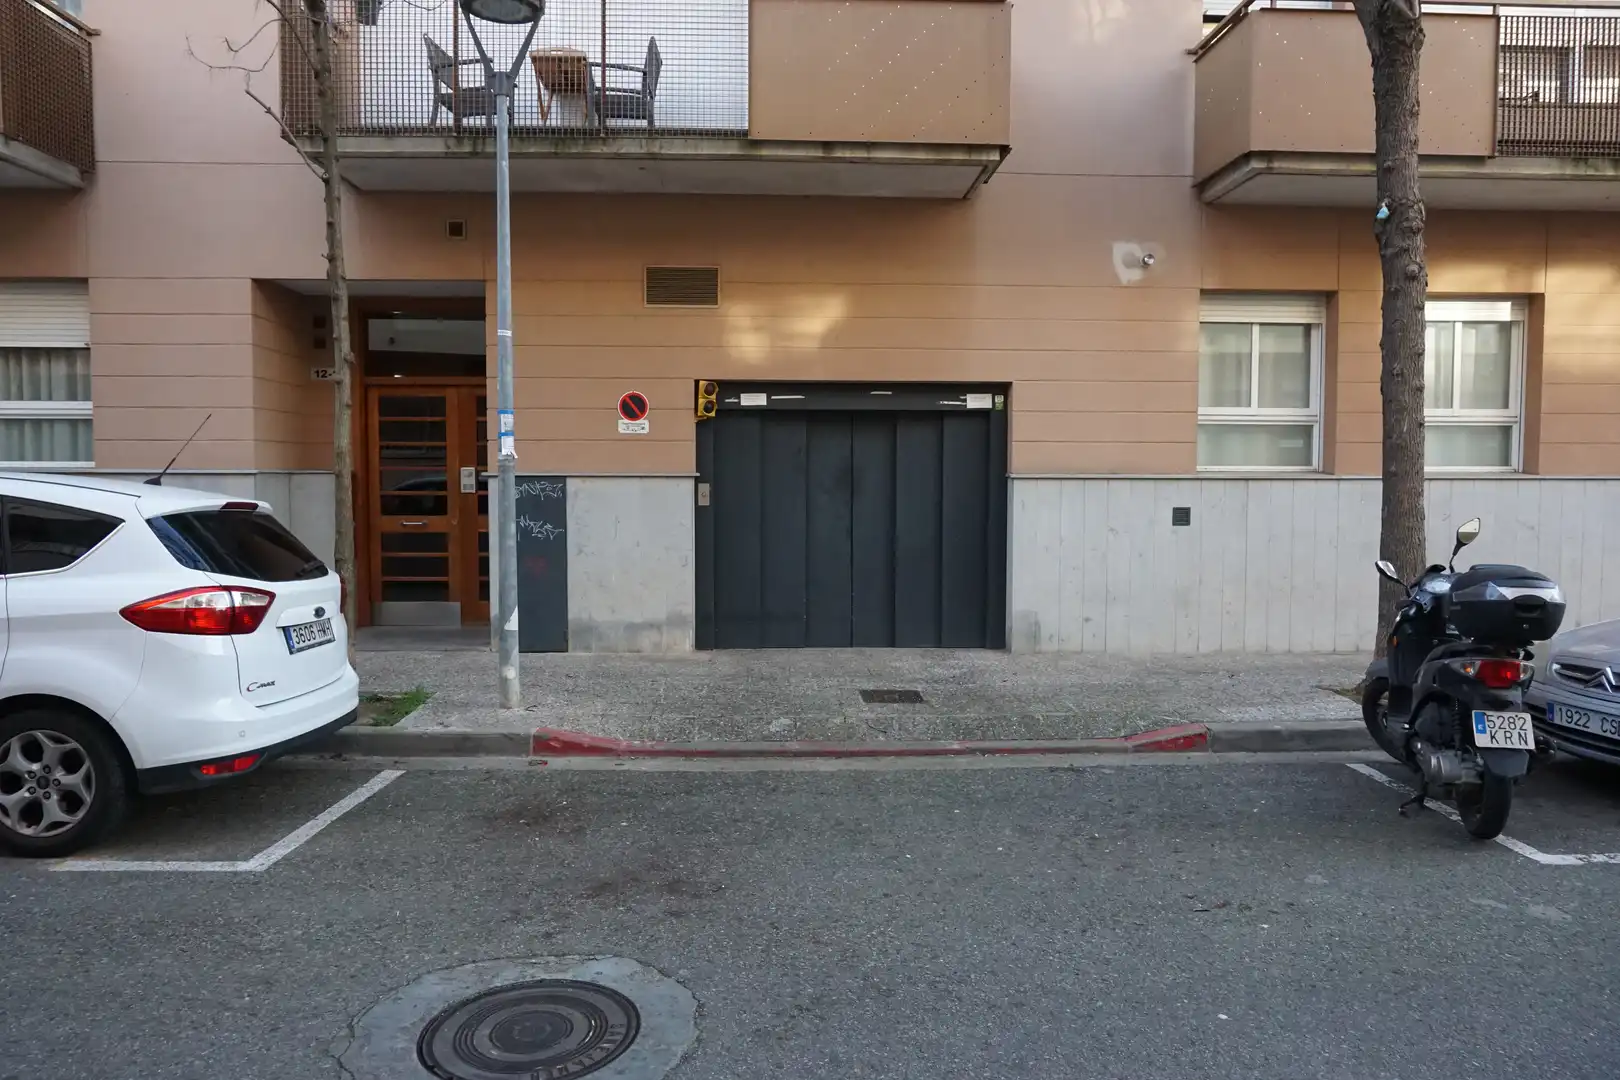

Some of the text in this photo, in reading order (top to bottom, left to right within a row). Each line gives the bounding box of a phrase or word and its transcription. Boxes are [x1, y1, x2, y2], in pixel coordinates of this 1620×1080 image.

[314, 369, 336, 379] 12-
[293, 624, 316, 645] 3606
[1486, 714, 1527, 731] 5282
[1559, 707, 1620, 736] 1922 CS
[1490, 729, 1528, 746] KRN
